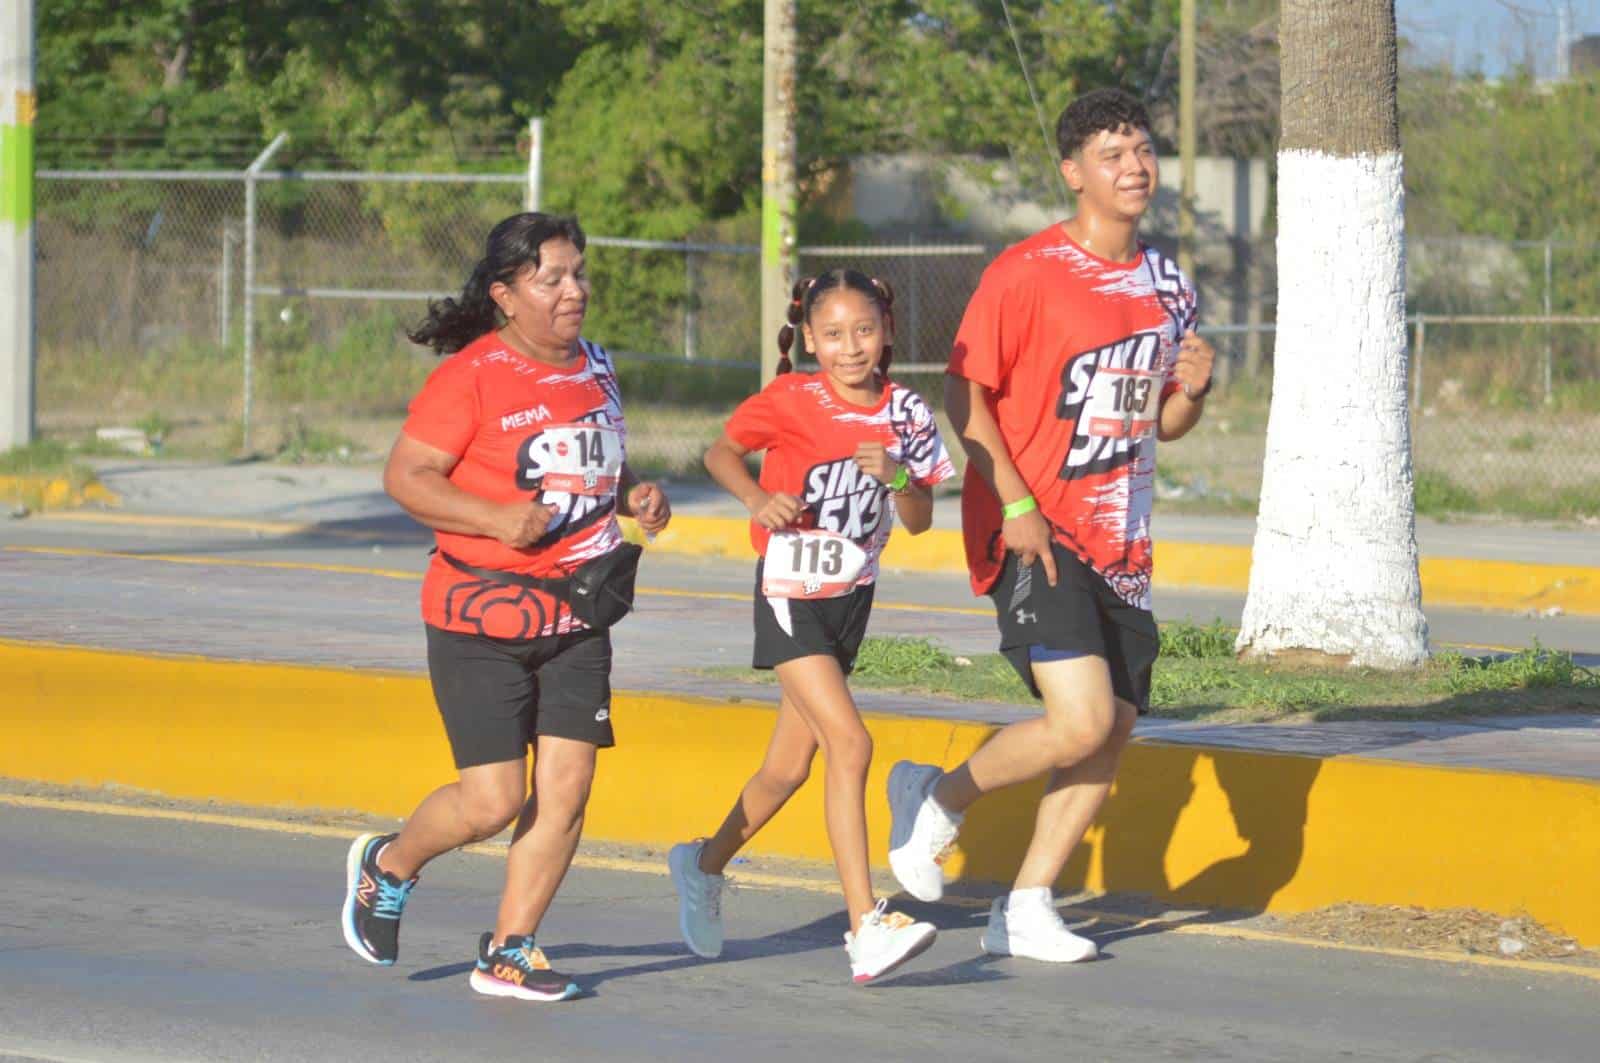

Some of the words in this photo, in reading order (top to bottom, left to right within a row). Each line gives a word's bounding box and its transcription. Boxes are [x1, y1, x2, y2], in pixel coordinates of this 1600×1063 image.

[1111, 376, 1152, 413] 183
[501, 404, 552, 432] MEMA
[574, 430, 605, 467] 14
[788, 537, 843, 576] 113
